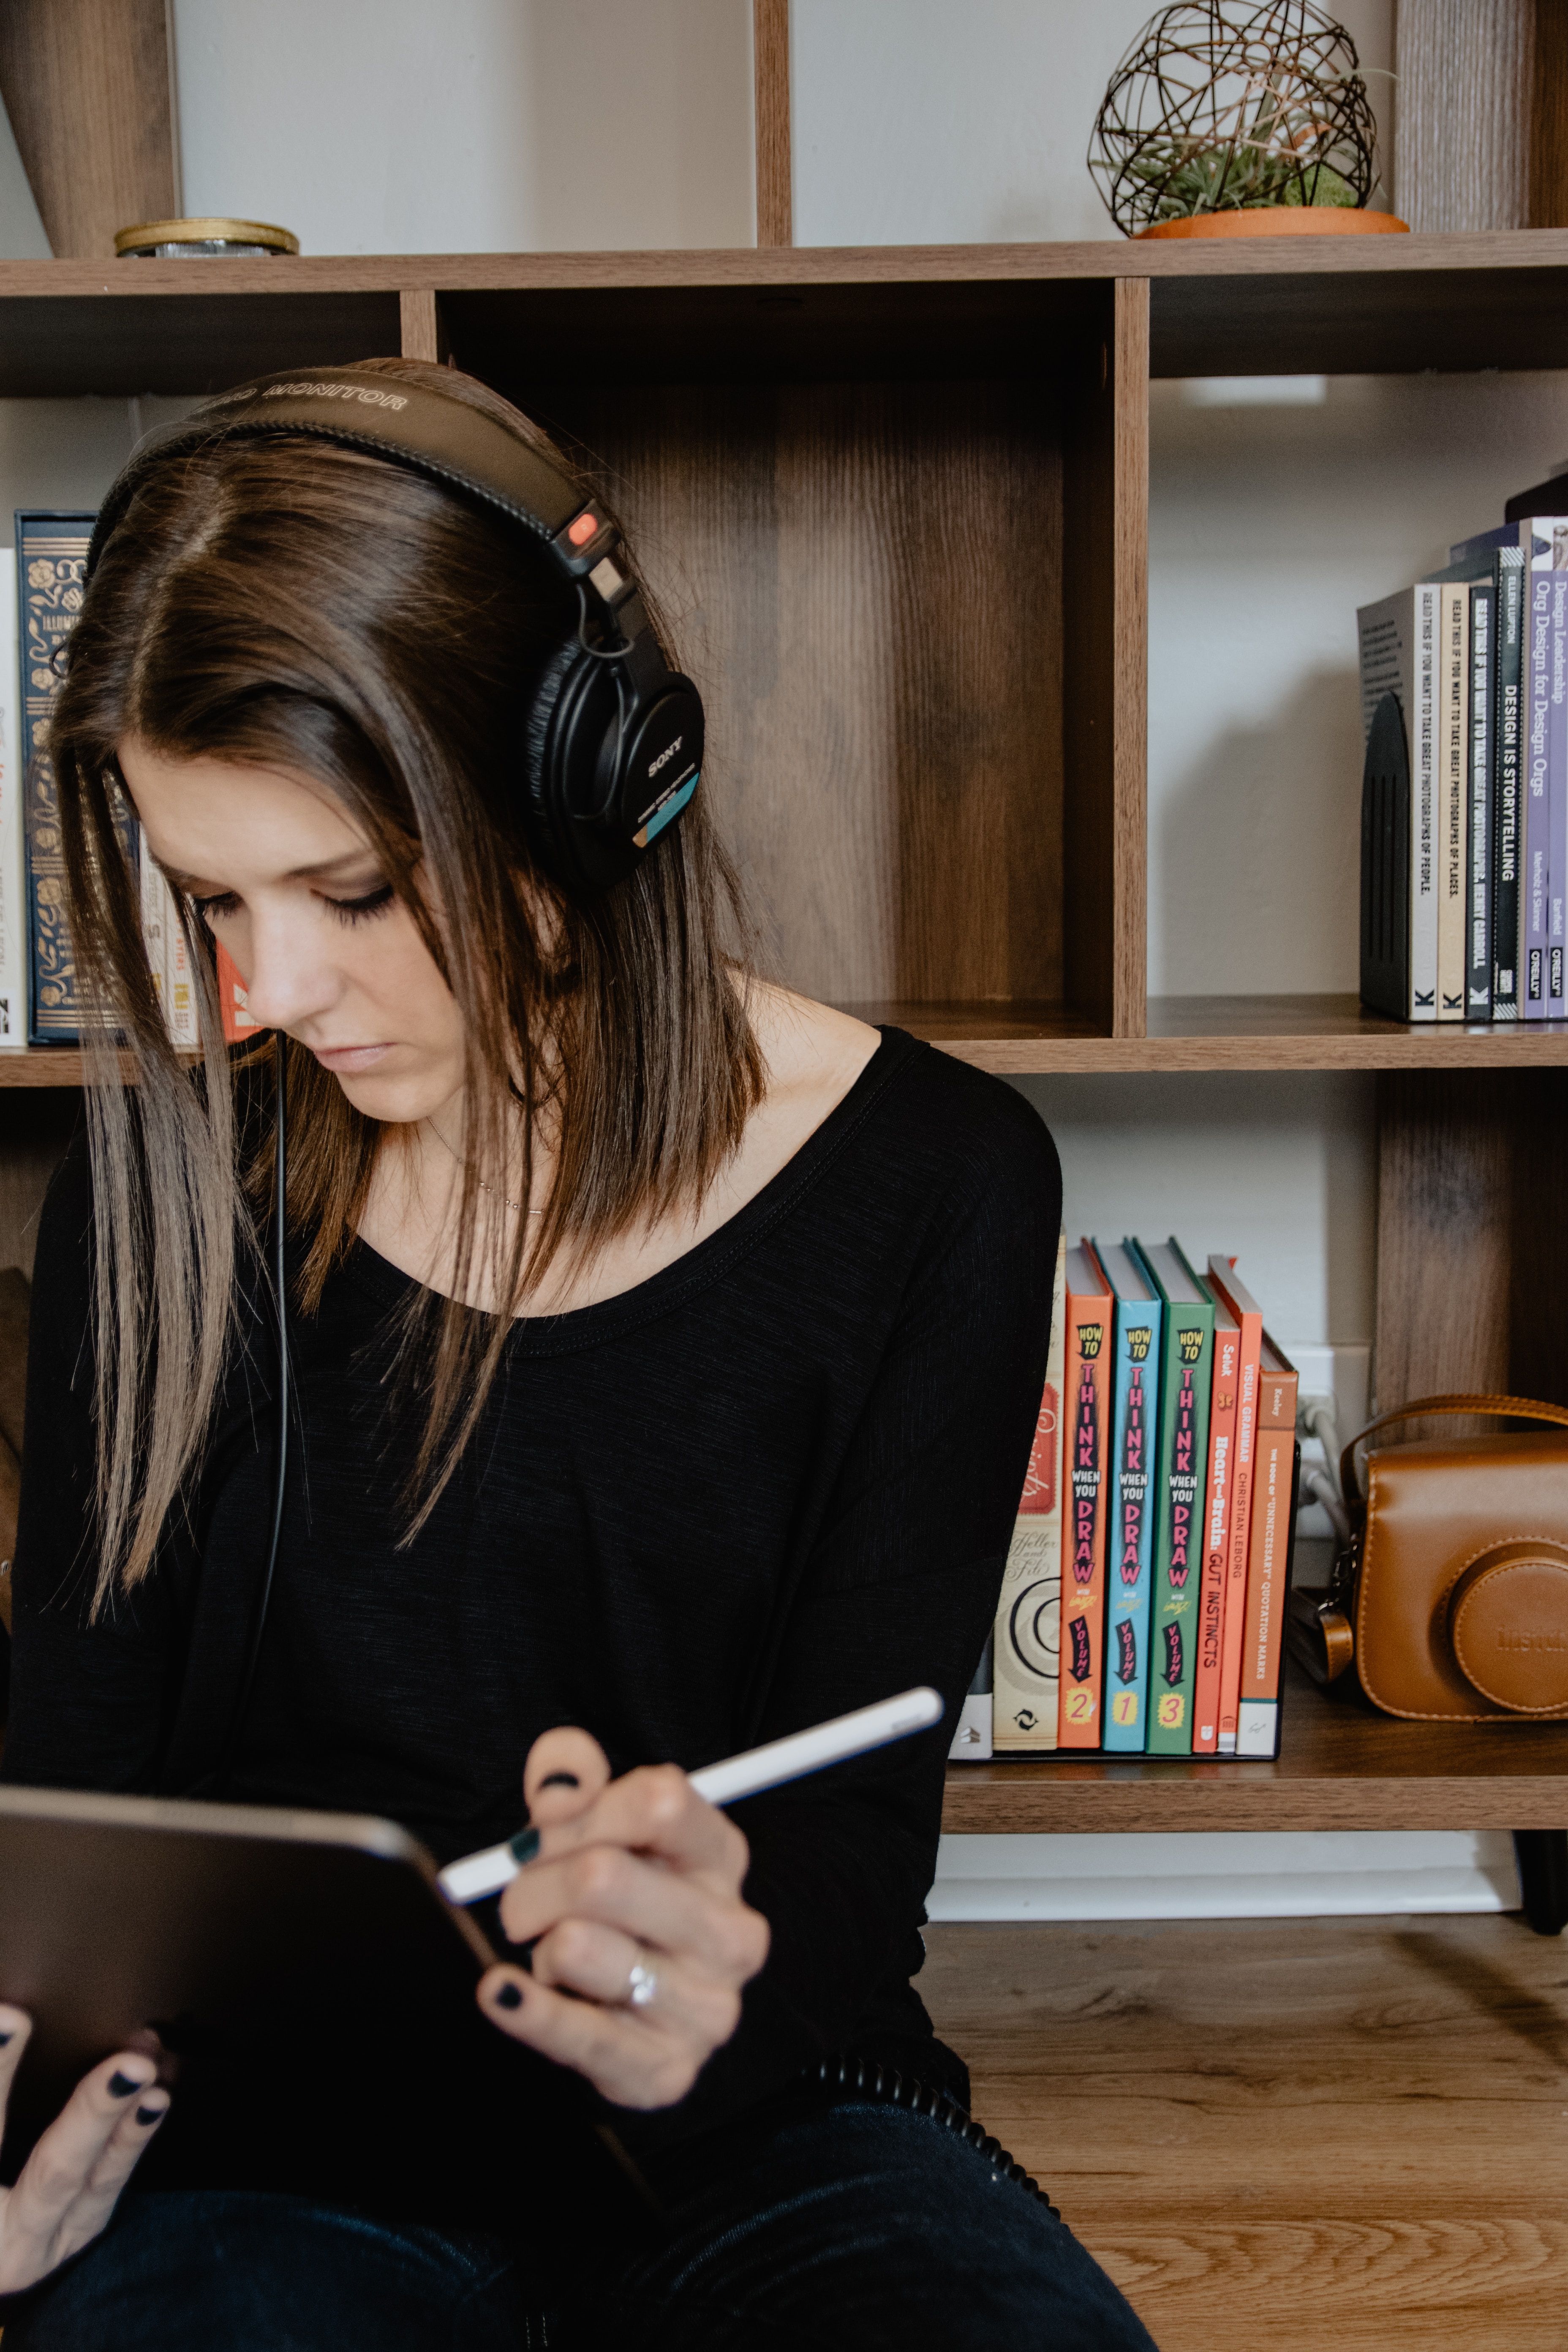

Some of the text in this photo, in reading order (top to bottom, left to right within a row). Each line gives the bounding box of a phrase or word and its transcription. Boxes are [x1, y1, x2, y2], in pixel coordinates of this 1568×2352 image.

[262, 382, 408, 410] MONITOR
[1453, 599, 1462, 623] READ
[1507, 575, 1516, 644] ELLEN LUPTON
[1452, 625, 1461, 646] THIS
[1552, 580, 1567, 704] Design Leadership
[1422, 654, 1432, 671] YOU
[1452, 660, 1460, 678] YOU
[1474, 655, 1487, 667] IF
[1422, 673, 1432, 699] WANT
[1474, 667, 1487, 689] YOU
[1530, 580, 1550, 797] Org Design for Design Orgs
[1451, 681, 1460, 705] WANT
[1474, 689, 1486, 721] WANT
[1422, 703, 1431, 714] TO
[1451, 710, 1460, 721] TO
[1422, 717, 1431, 740] TAKE
[1451, 725, 1460, 746] TAKE
[1474, 721, 1486, 738] TO
[648, 736, 682, 778] SONY
[1422, 742, 1431, 770] GREAT
[1451, 749, 1459, 777] GREAT
[1474, 738, 1486, 767] TAKE
[1502, 685, 1517, 881] DESIGN IS STORYTELLING
[1421, 773, 1431, 840] PHOTOGRAPHS
[1450, 780, 1459, 844] PHOTOGRAPHS
[1421, 842, 1430, 855] OF
[1450, 848, 1459, 859] OF
[1420, 857, 1430, 896] PEOPLE.
[1449, 862, 1459, 898] PLACES.
[1473, 883, 1486, 918] HENRY
[1533, 851, 1542, 932] Merholz & Skinner
[1473, 919, 1486, 969] CARROLL
[1415, 989, 1434, 1006] K
[1443, 993, 1462, 1009] K
[1469, 986, 1489, 1005] K
[1079, 1326, 1104, 1341] HOW
[1128, 1329, 1152, 1344] HOW
[1180, 1331, 1204, 1346] HOW
[1084, 1341, 1098, 1356] TO
[1133, 1345, 1146, 1358] TO
[1184, 1346, 1198, 1360] TO
[1221, 1344, 1234, 1377] Seluk
[1239, 1364, 1255, 1462] VISUAL GRAMMAR
[1271, 1388, 1282, 1416] Keeley
[1078, 1364, 1094, 1467] THINK
[1127, 1367, 1143, 1470] THINK
[1176, 1369, 1194, 1471] THINK
[1213, 1436, 1228, 1485] Heart
[1072, 1470, 1101, 1484] WHEN
[1119, 1473, 1148, 1486] WHEN
[1169, 1475, 1198, 1488] WHEN
[1269, 1484, 1275, 1495] OF
[1075, 1484, 1096, 1497] YOU
[1122, 1487, 1144, 1500] YOU
[1172, 1490, 1193, 1503] YOU
[1233, 1473, 1247, 1579] CHRISTIAN LEBORG
[1010, 1532, 1058, 1557] Heller
[1023, 1549, 1047, 1557] and
[1073, 1501, 1094, 1583] DRAW
[1120, 1504, 1141, 1585] DRAW
[1168, 1505, 1190, 1588] DRAW
[1003, 1558, 1050, 1582] Fili
[1208, 1553, 1223, 1585] GUT
[1259, 1581, 1271, 1643] QUOTATION
[1203, 1591, 1221, 1669] INSTINCTS
[1075, 1620, 1087, 1677] VOLUME
[1121, 1623, 1134, 1680] VOLUME
[1168, 1625, 1181, 1682] VOLUME
[1256, 1644, 1267, 1680] MARKS
[1071, 1693, 1087, 1718] 2
[1121, 1696, 1131, 1721] 1
[1162, 1698, 1180, 1723] 3
